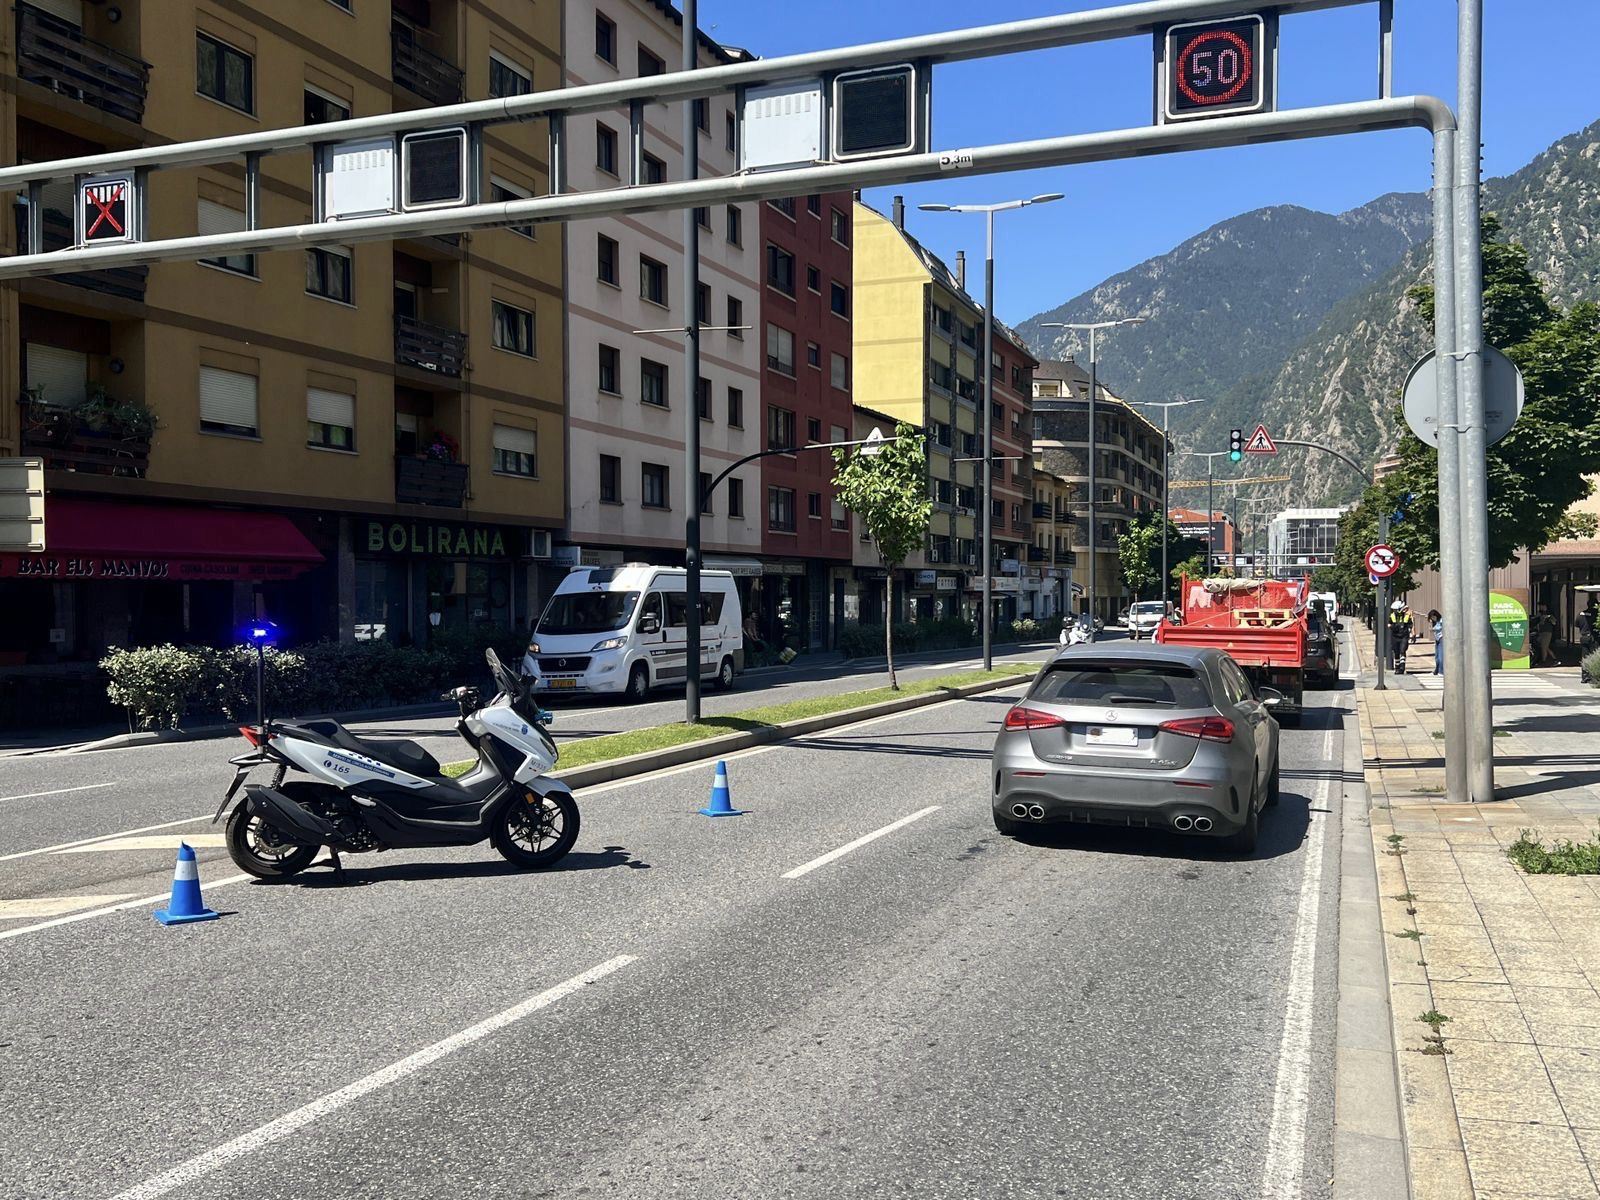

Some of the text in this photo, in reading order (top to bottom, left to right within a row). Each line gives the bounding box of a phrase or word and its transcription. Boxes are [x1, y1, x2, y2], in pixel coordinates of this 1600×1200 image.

[1192, 48, 1238, 87] 50
[368, 522, 506, 556] BOLIRANA
[17, 557, 60, 577] BAR
[65, 558, 95, 577] ELS
[333, 764, 351, 774] 165
